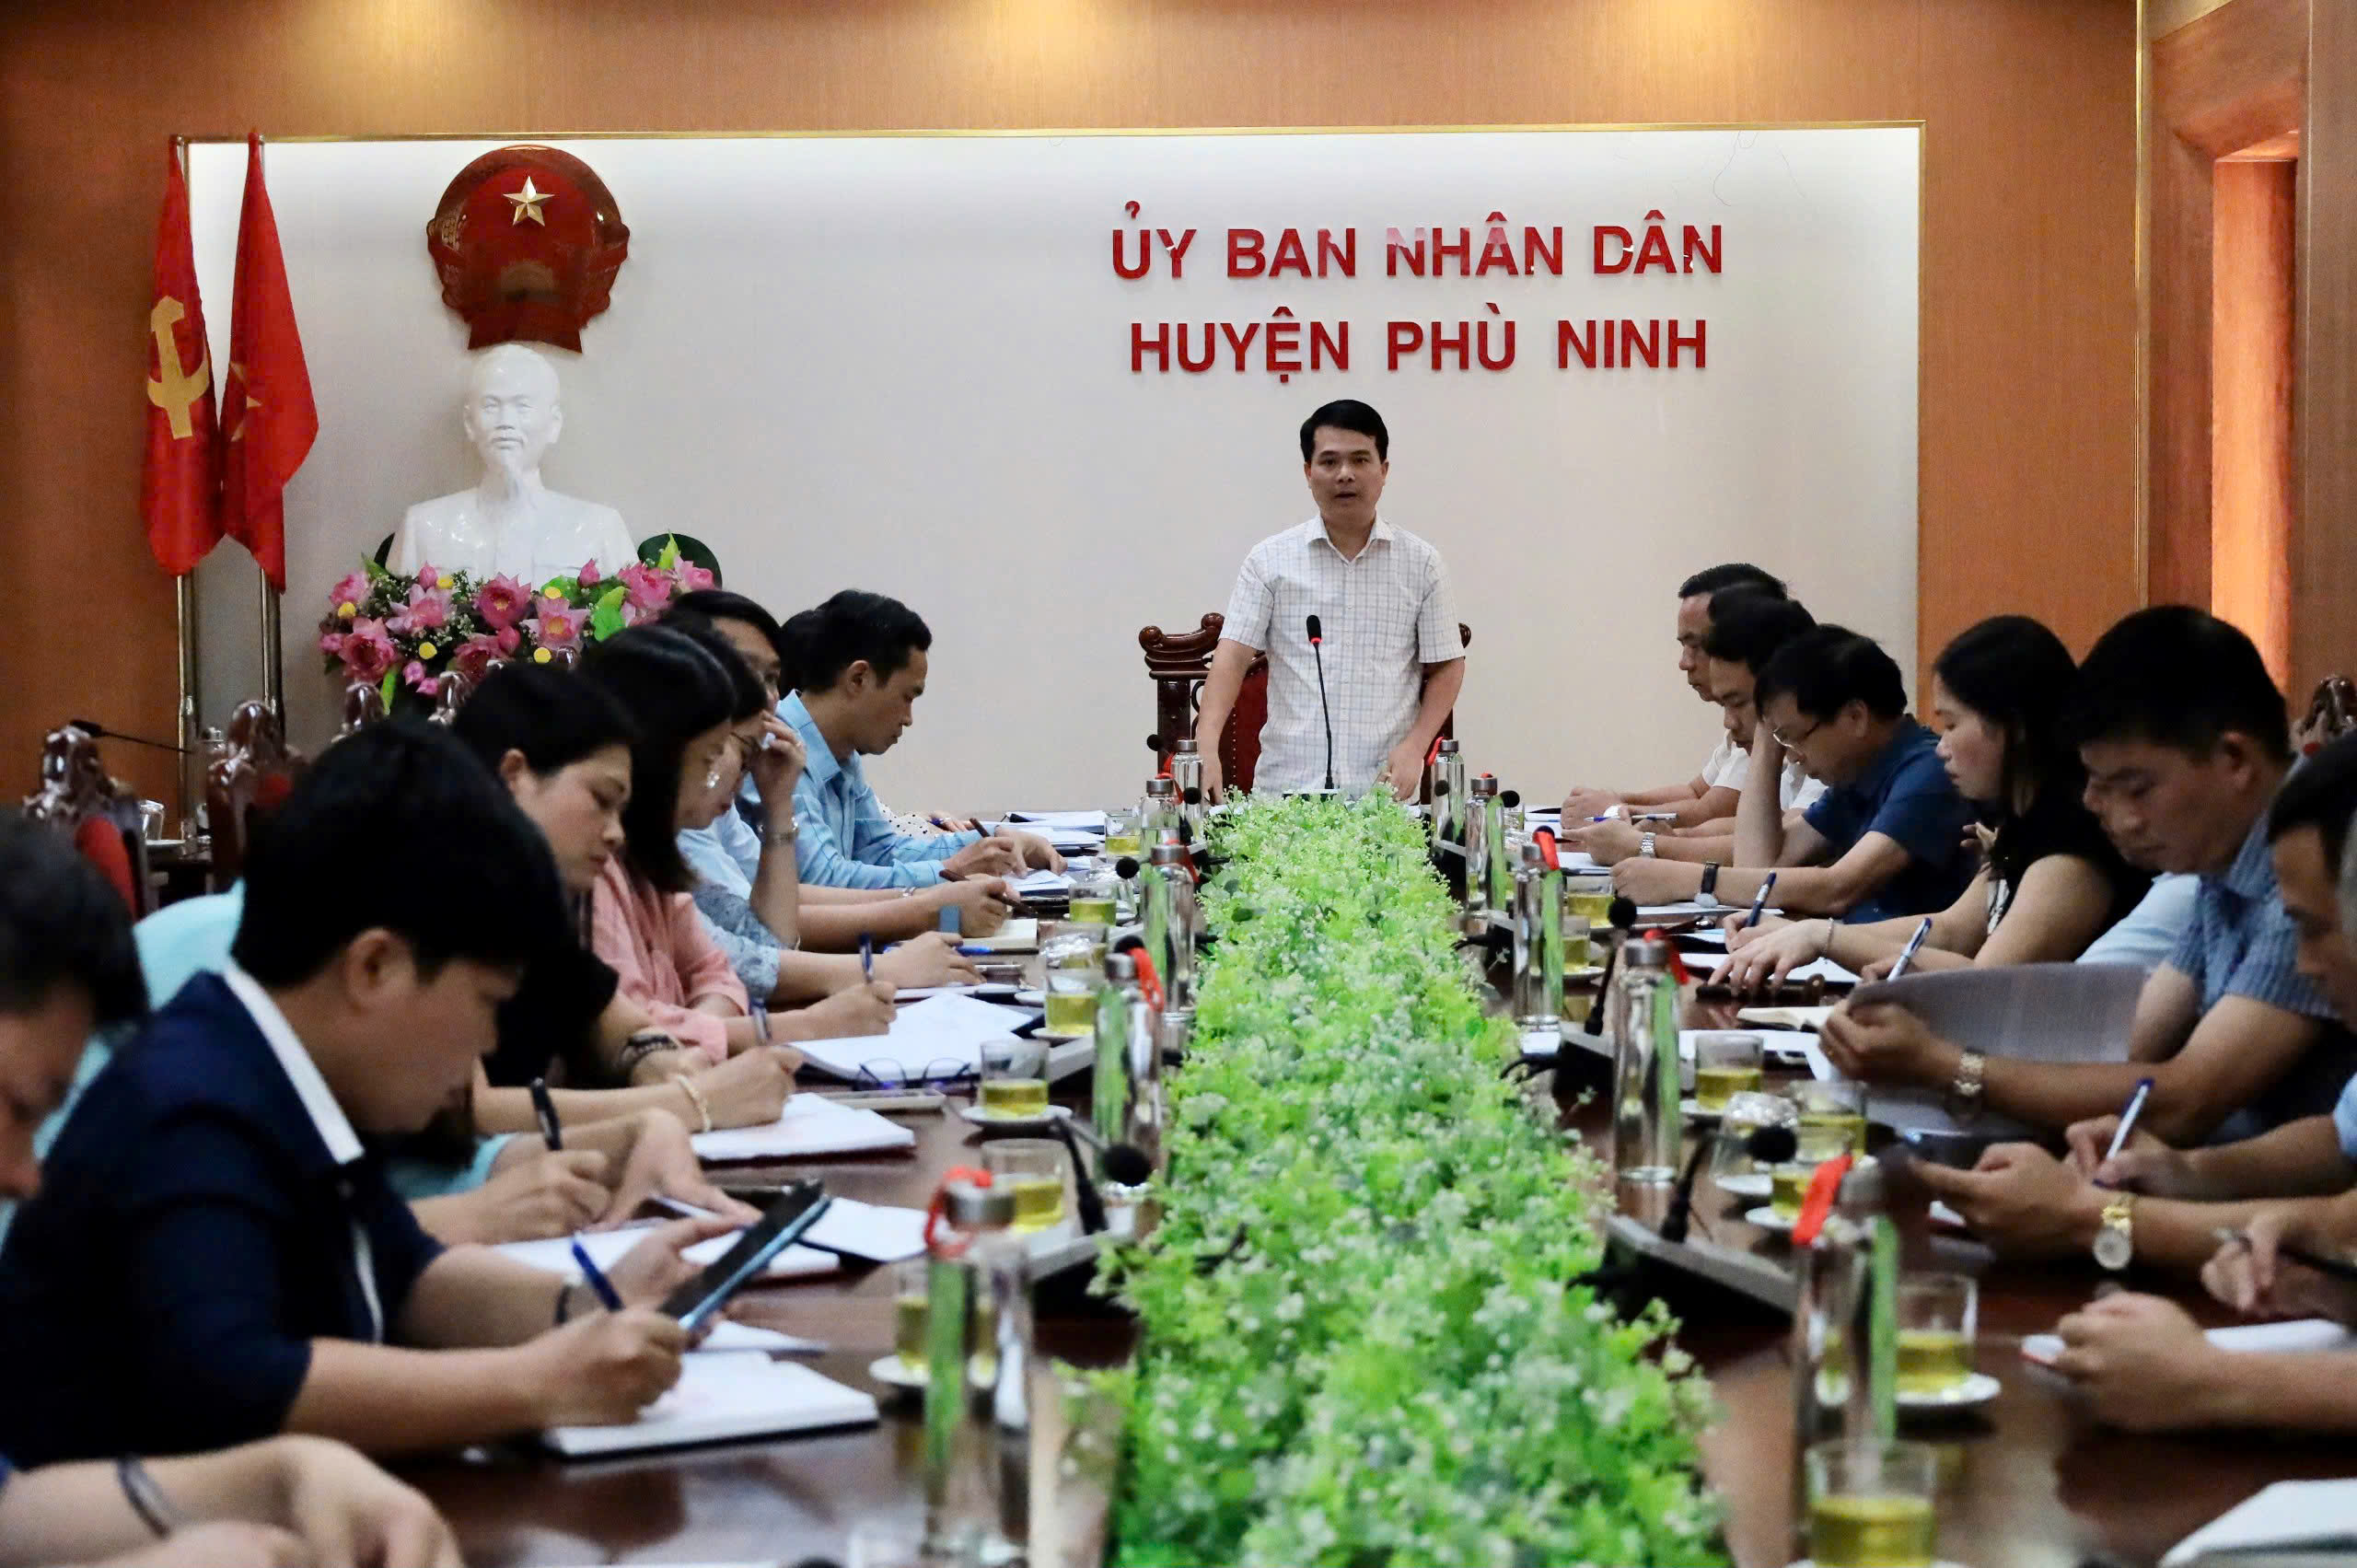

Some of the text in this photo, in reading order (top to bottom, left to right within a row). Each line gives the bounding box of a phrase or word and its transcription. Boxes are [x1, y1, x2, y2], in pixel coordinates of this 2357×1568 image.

[1112, 200, 1723, 280] ỦY BAN NHÂN DÂN
[1131, 302, 1707, 384] HUYỆN PHÙ NINH
